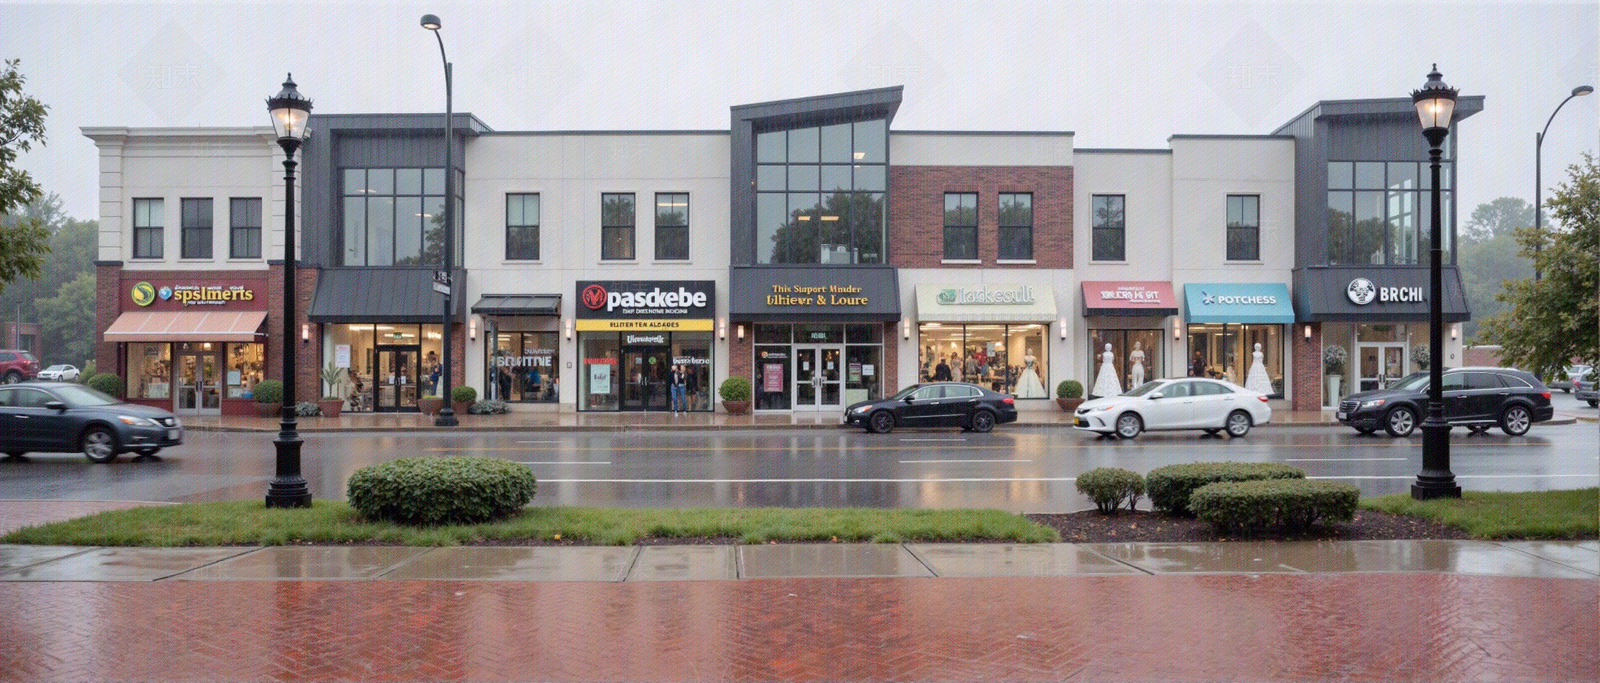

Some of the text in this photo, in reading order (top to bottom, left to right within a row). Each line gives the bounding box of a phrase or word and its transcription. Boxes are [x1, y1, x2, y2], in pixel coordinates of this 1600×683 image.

[816, 294, 827, 305] &
[1218, 295, 1277, 304] POTCHESS
[1380, 286, 1423, 302] BRCHI
